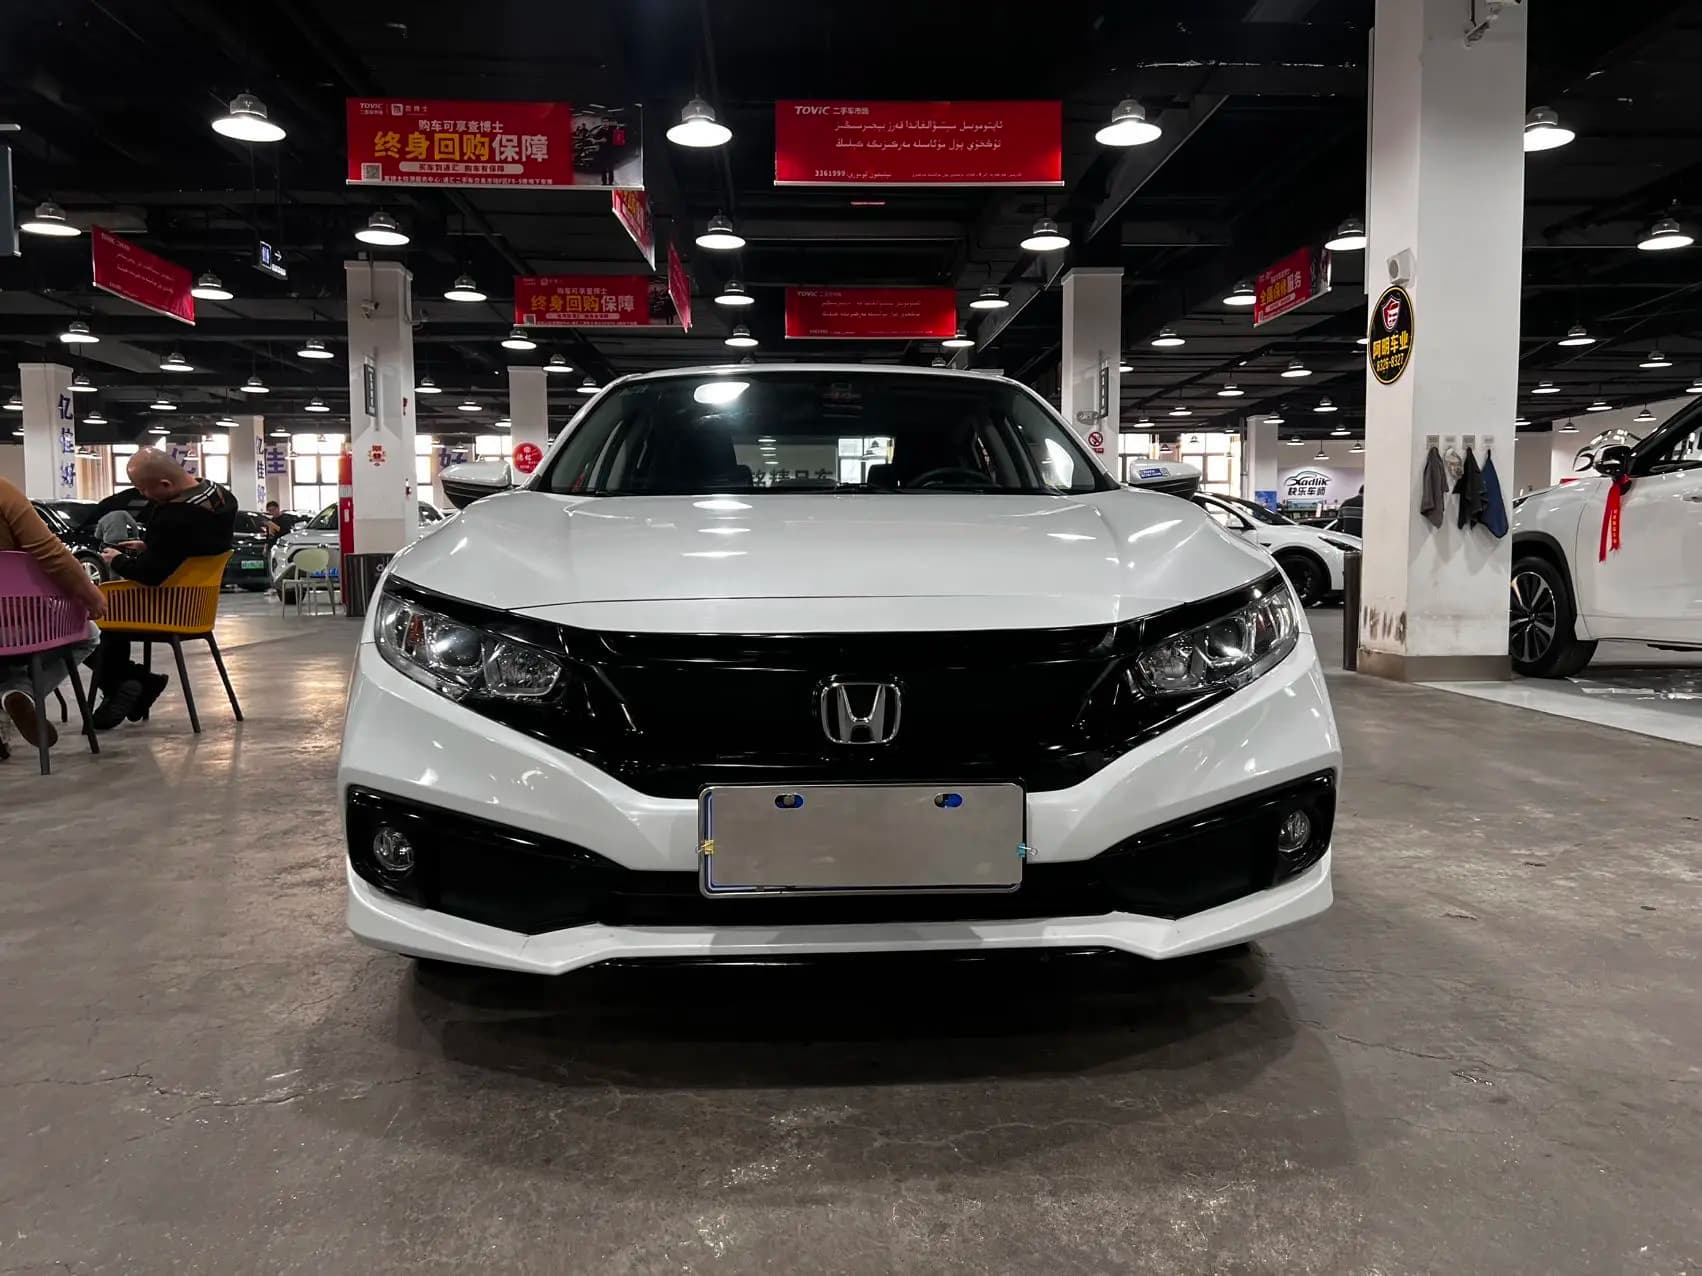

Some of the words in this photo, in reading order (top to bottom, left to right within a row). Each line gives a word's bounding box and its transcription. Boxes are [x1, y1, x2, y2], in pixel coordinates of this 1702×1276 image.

[794, 105, 830, 115] TOVIC
[419, 119, 504, 133] 购车可享查博士
[374, 131, 549, 162] 终身回购保障
[531, 295, 635, 313] 终身回购保障
[1372, 331, 1409, 360] 阿明车业
